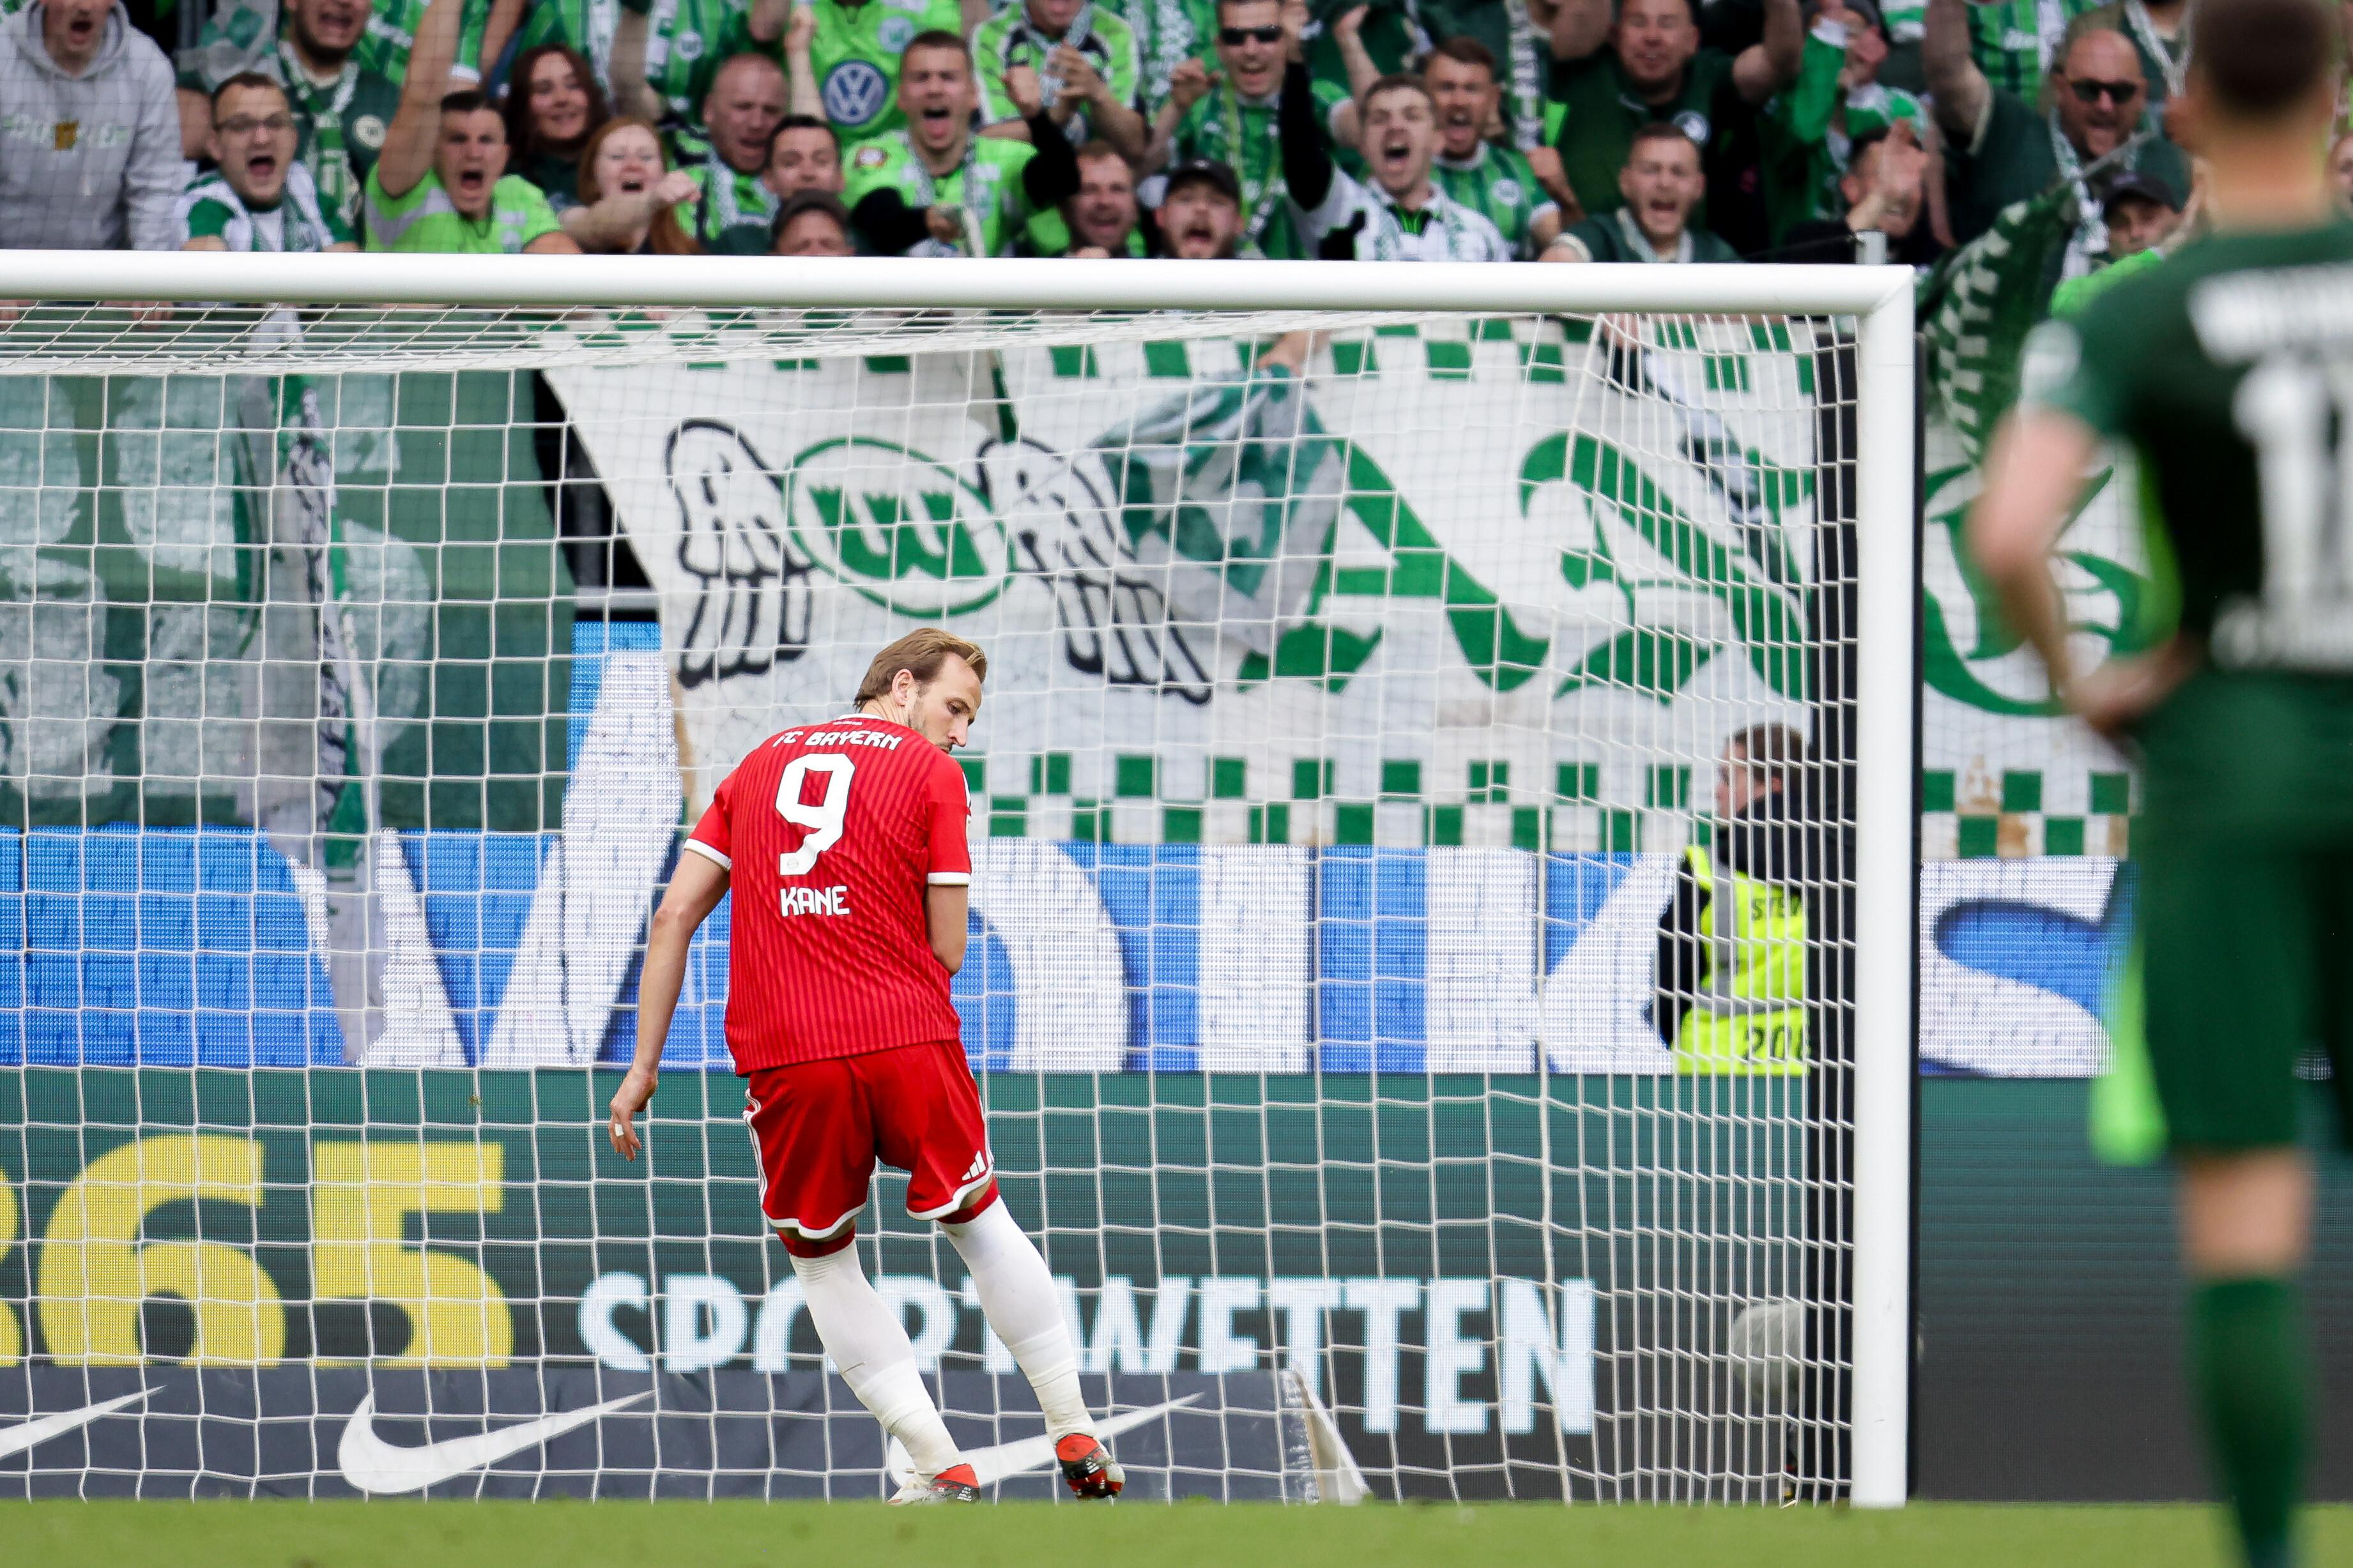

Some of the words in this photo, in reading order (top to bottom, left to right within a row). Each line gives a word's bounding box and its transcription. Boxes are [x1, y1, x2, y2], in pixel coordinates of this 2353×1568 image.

[804, 730, 903, 750] BAYERN
[775, 753, 855, 876] 9
[779, 885, 851, 917] KANE
[0, 1134, 514, 1368] 65
